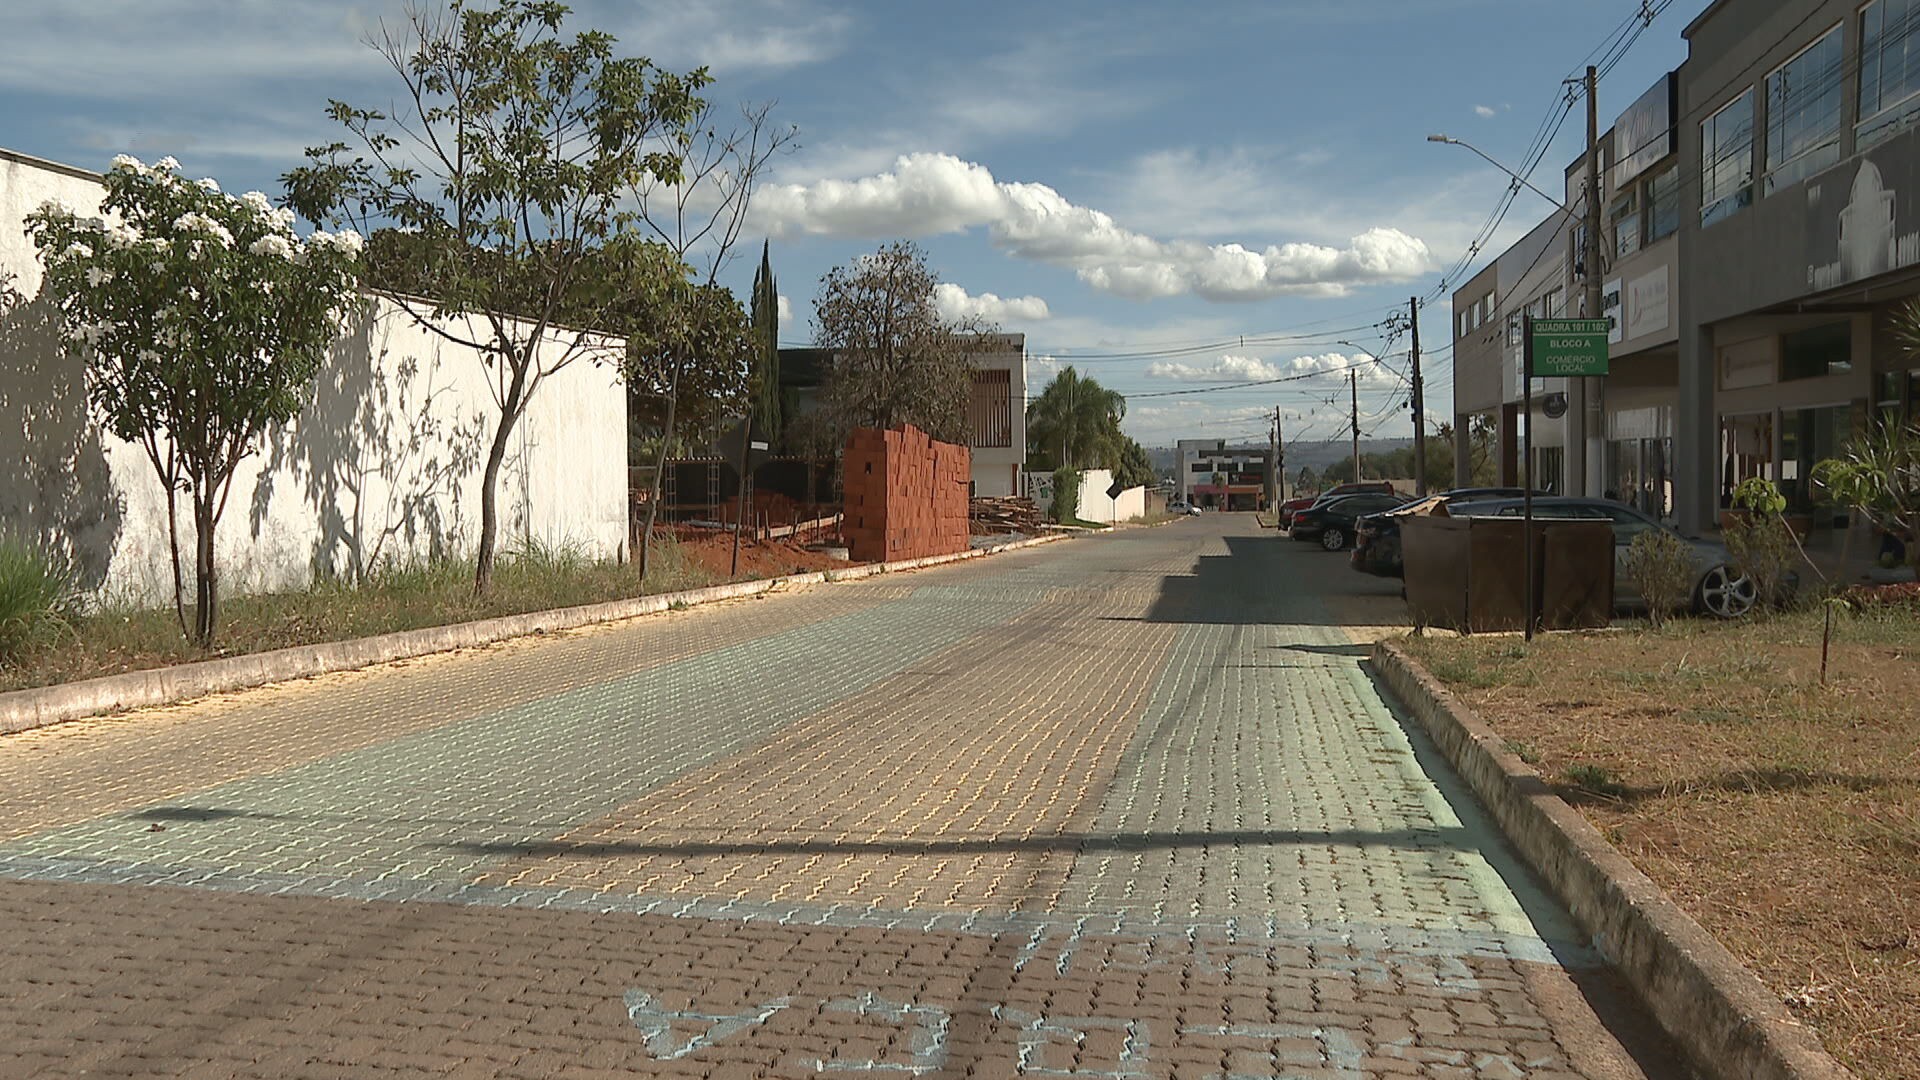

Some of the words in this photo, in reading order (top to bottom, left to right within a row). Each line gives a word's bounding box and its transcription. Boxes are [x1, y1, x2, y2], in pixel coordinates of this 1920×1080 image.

[1535, 323, 1570, 332] QUADRA
[1572, 322, 1585, 331] 101
[1592, 322, 1606, 331] 102
[1550, 339, 1582, 348] BLOCO
[1583, 339, 1591, 348] A
[1556, 364, 1585, 373] LOCAL
